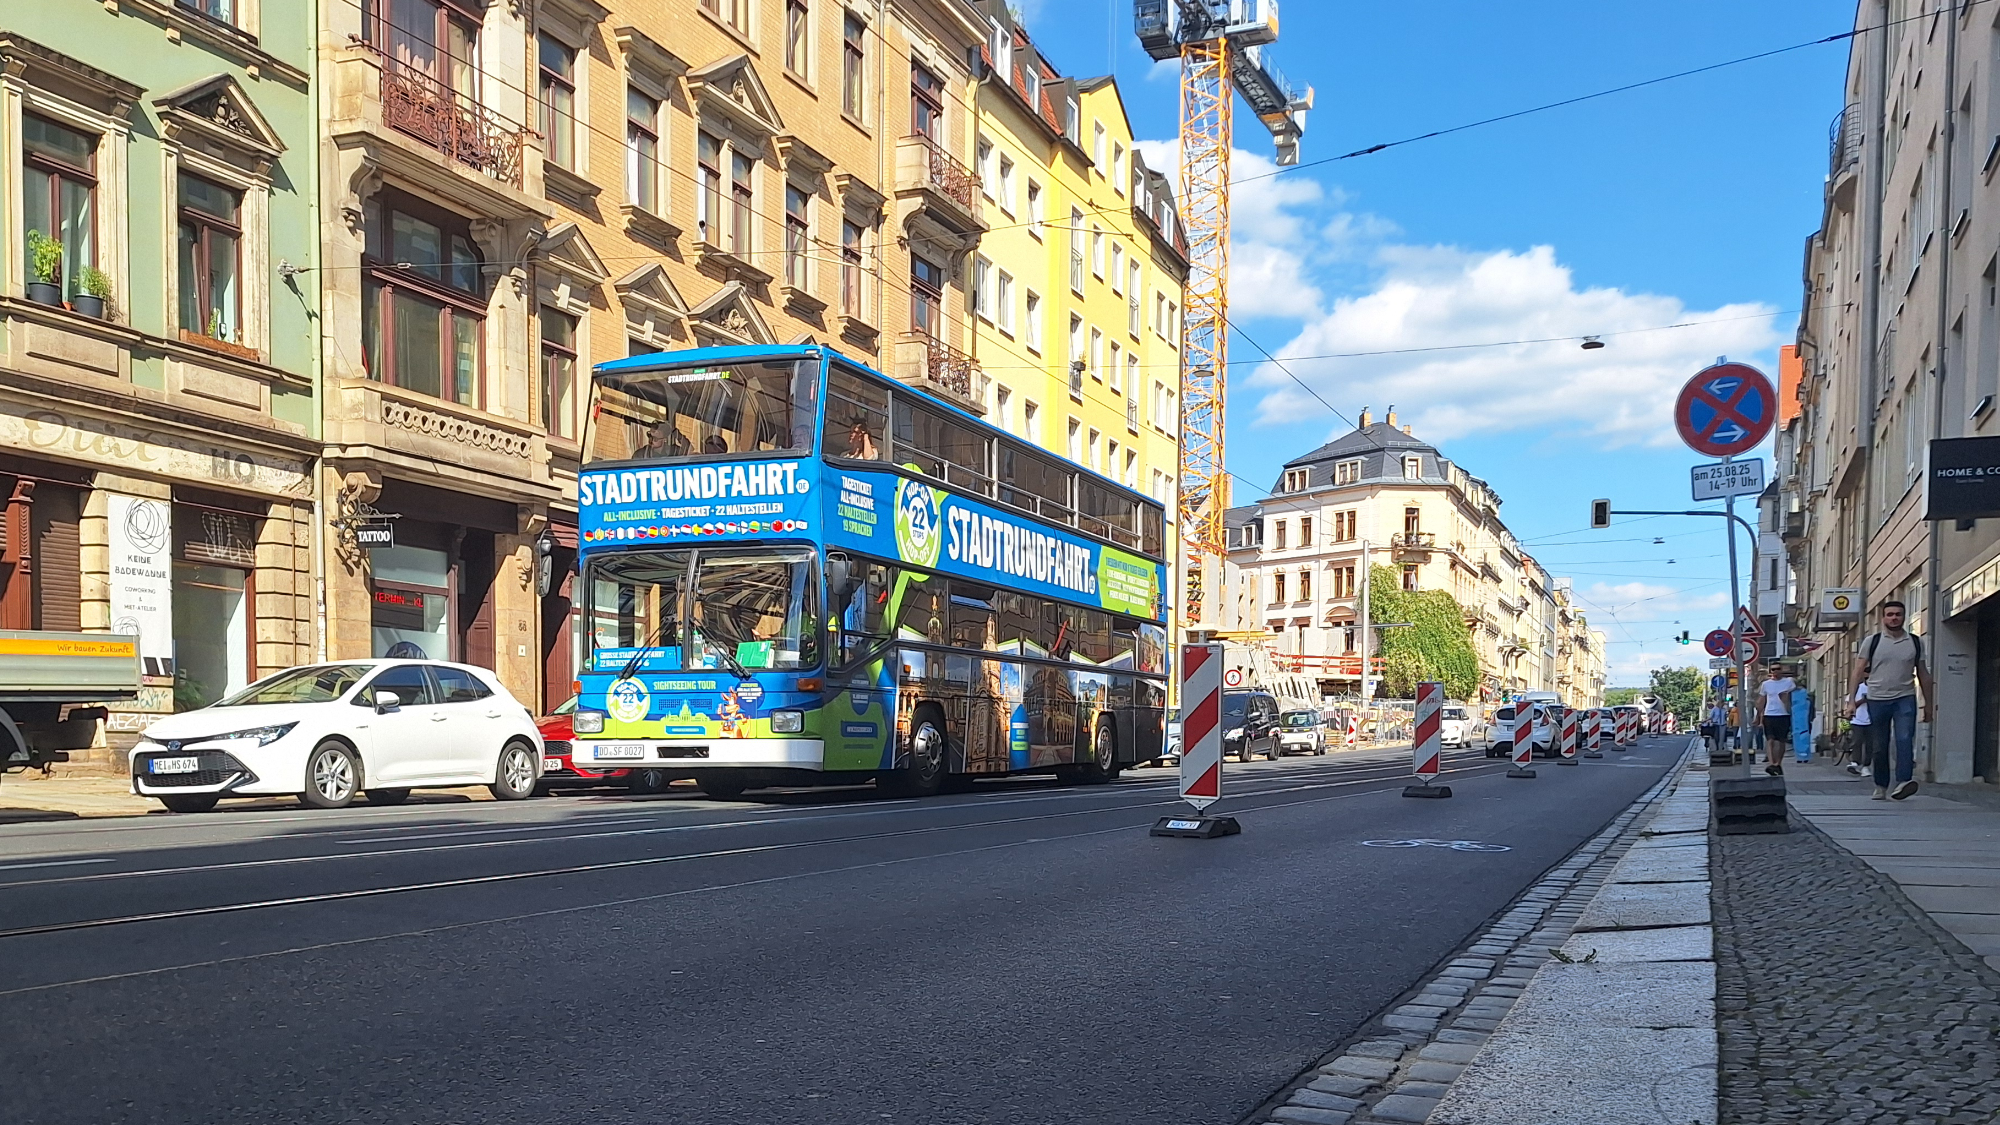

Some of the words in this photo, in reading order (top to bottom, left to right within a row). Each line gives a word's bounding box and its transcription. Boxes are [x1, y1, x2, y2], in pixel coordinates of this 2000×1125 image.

[1694, 471, 1709, 481] am
[1710, 464, 1750, 479] 25.08.25
[1937, 468, 1973, 478] HOME
[1975, 467, 1984, 476] &
[580, 462, 798, 506] STADTRUNDFAHRT
[841, 475, 873, 496] TAGESTICKET
[1708, 476, 1736, 492] 14-19
[1741, 476, 1758, 487] Uhr
[840, 490, 874, 510] ALL-INCLUSIVE
[905, 481, 931, 506] HOP-ON
[603, 508, 657, 522] ALL-INCLUSIVE
[661, 506, 711, 520] TAGESTICKET
[715, 504, 725, 516] 22
[726, 502, 784, 516] HALTESTELLEN
[838, 503, 845, 516] 22
[845, 505, 878, 525] HALTESTELLEN
[912, 505, 926, 530] 22
[358, 530, 390, 542] TATTOO
[848, 520, 873, 538] SPRACHEN
[905, 538, 931, 563] HOP-OFF
[948, 505, 1090, 594] STADTRUNDFAHRT
[128, 554, 152, 565] KEINE
[114, 566, 167, 579] BADEWANNE
[124, 586, 156, 595] COWORKING
[57, 644, 72, 652] Wir
[74, 644, 97, 653] bauen
[653, 680, 697, 691] SIGHTSEEING
[697, 680, 716, 690] TOUR
[622, 694, 634, 704] 22
[599, 746, 608, 756] DD
[614, 746, 622, 756] SF
[624, 746, 642, 756] 8027
[154, 760, 166, 770] MEI
[172, 760, 180, 770] HS
[182, 760, 196, 769] 674
